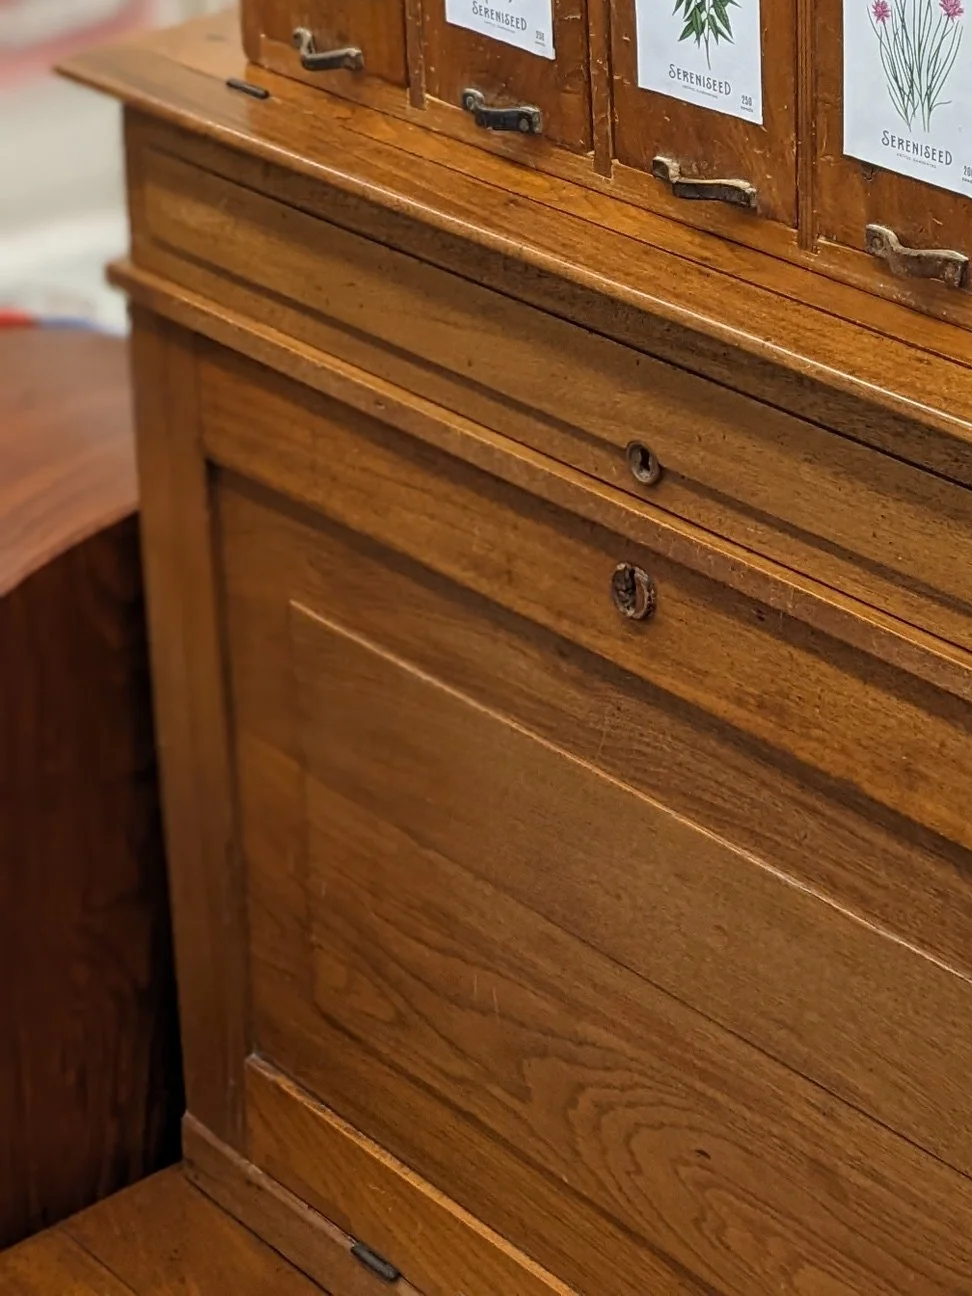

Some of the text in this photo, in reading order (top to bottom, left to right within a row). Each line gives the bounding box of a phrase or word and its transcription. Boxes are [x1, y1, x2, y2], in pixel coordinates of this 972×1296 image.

[471, 0, 528, 31] SERENISEED
[668, 63, 732, 96] SERENISEED
[881, 130, 953, 166] SERENISEED
